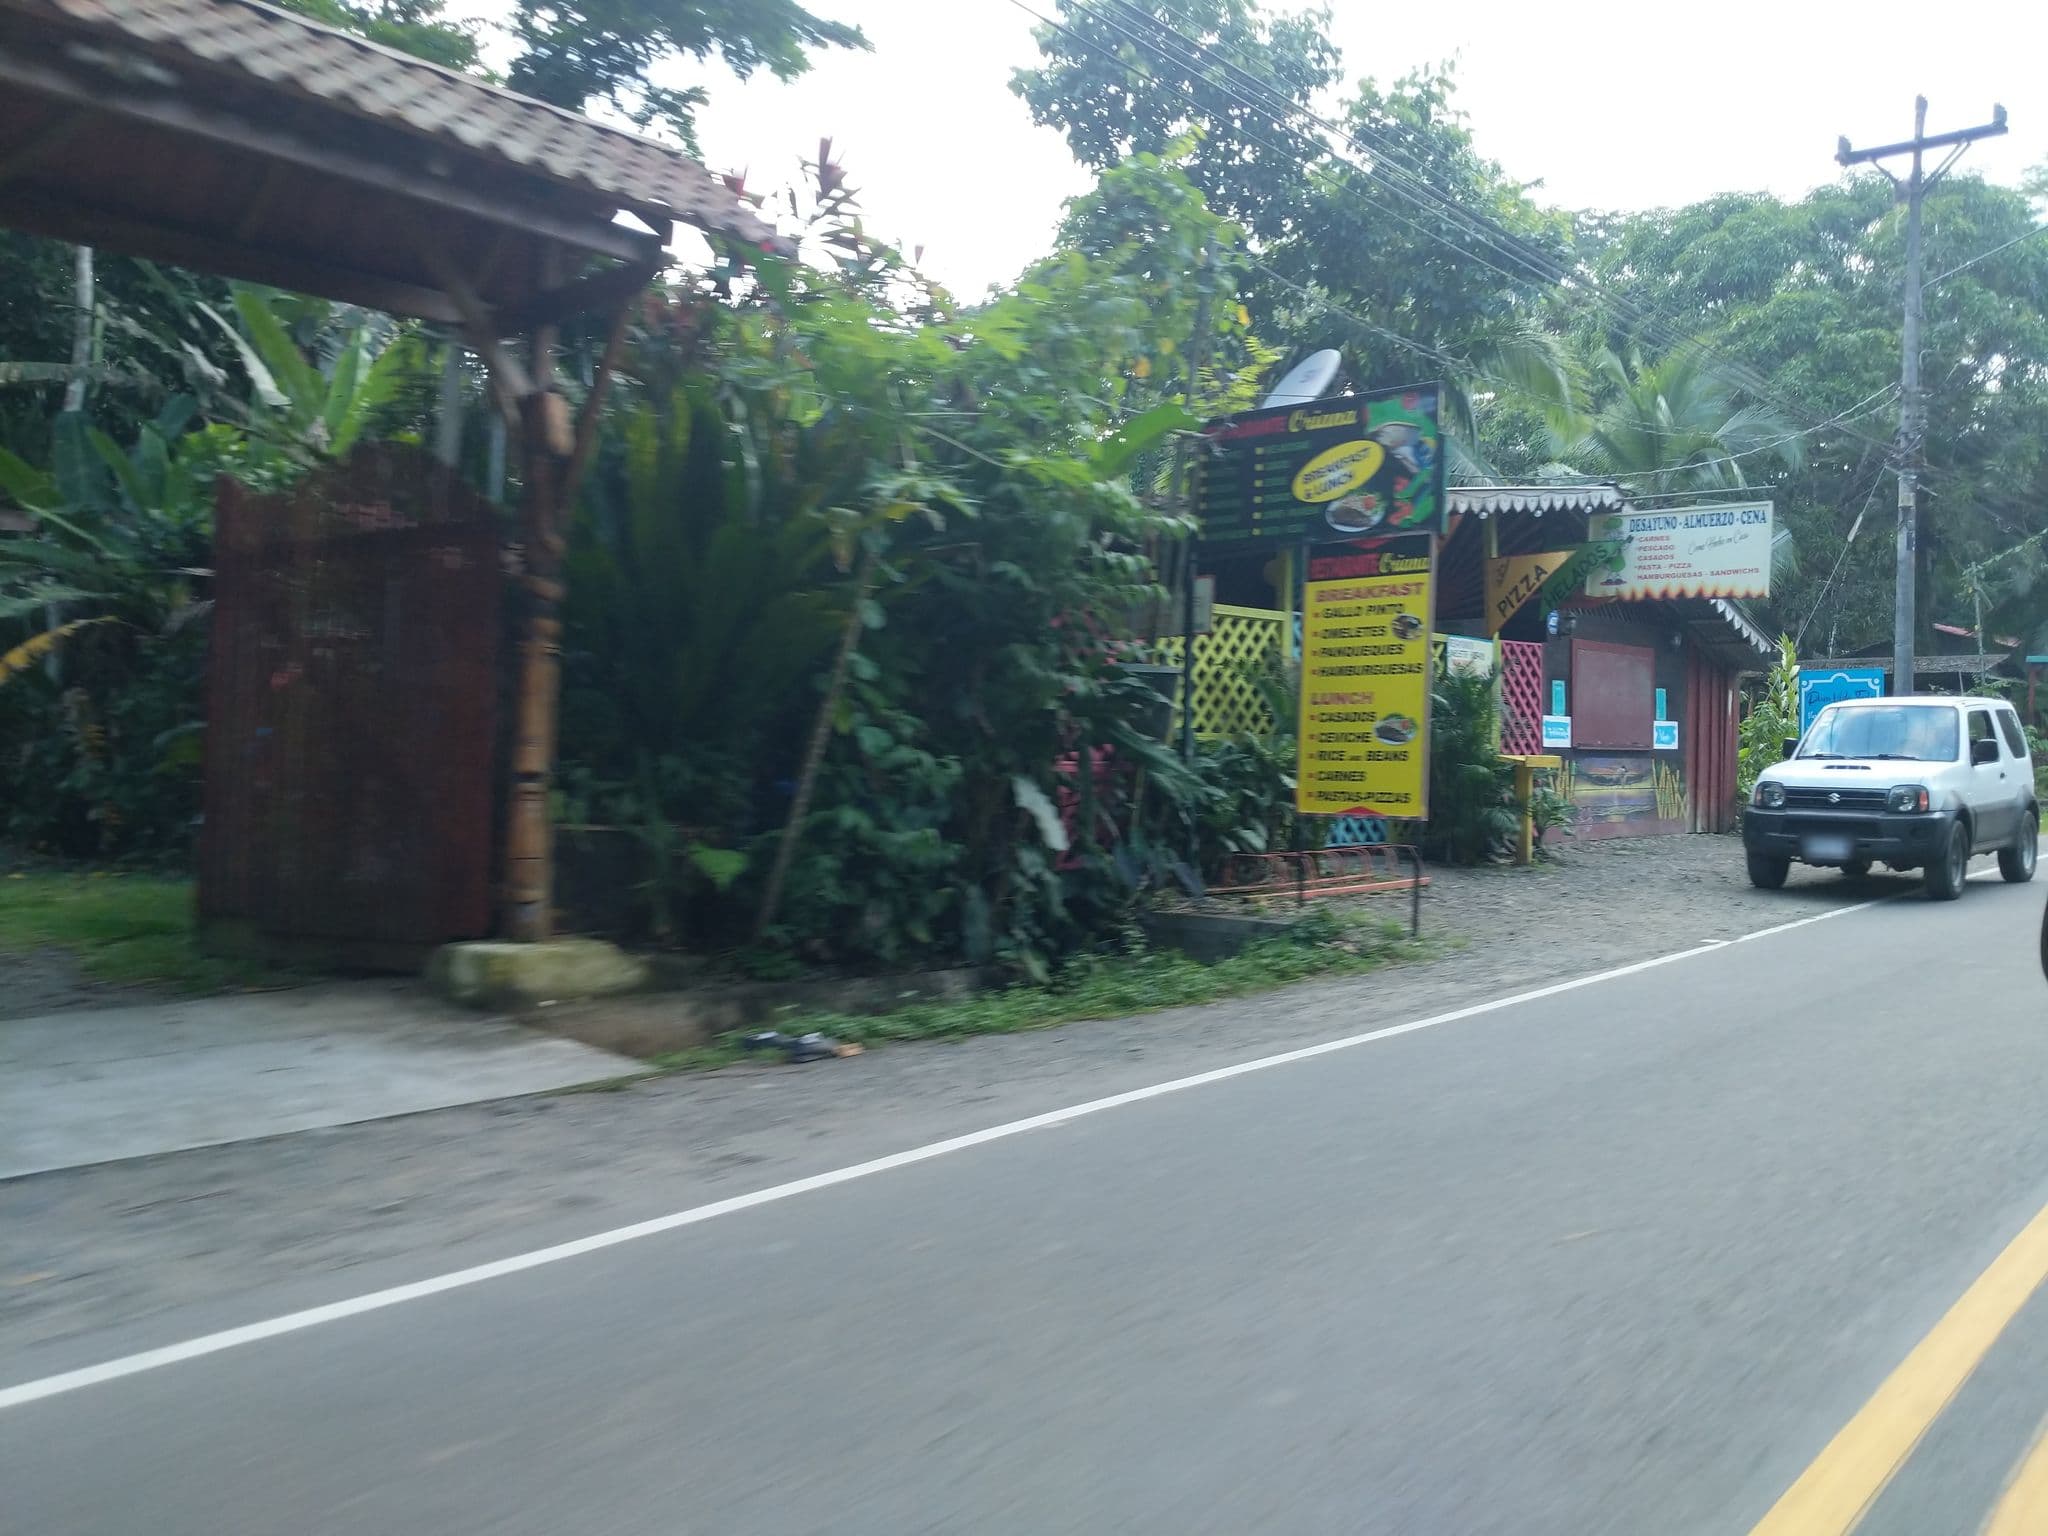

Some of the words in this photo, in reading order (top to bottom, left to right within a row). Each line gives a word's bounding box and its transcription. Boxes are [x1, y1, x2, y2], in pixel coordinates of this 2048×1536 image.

[1630, 516, 1677, 533] DESAYUNO
[1683, 512, 1734, 529] ALMUERZO
[1740, 510, 1766, 525] CENA
[1637, 572, 1702, 580] HAMBURGUESAS
[1710, 568, 1759, 577] SANDWICHS
[1316, 582, 1424, 602] BREAKFAST
[1496, 564, 1549, 619] PIZZA
[1323, 606, 1362, 618] GALLO
[1320, 663, 1423, 676] HAMBURGUESAS
[1311, 692, 1373, 705] LUNCH
[1318, 711, 1377, 723] CASADOS
[1318, 732, 1372, 743] CEVICHE
[1318, 750, 1346, 761] RICE
[1366, 750, 1408, 761] BEANS
[1318, 771, 1366, 782] CARNES
